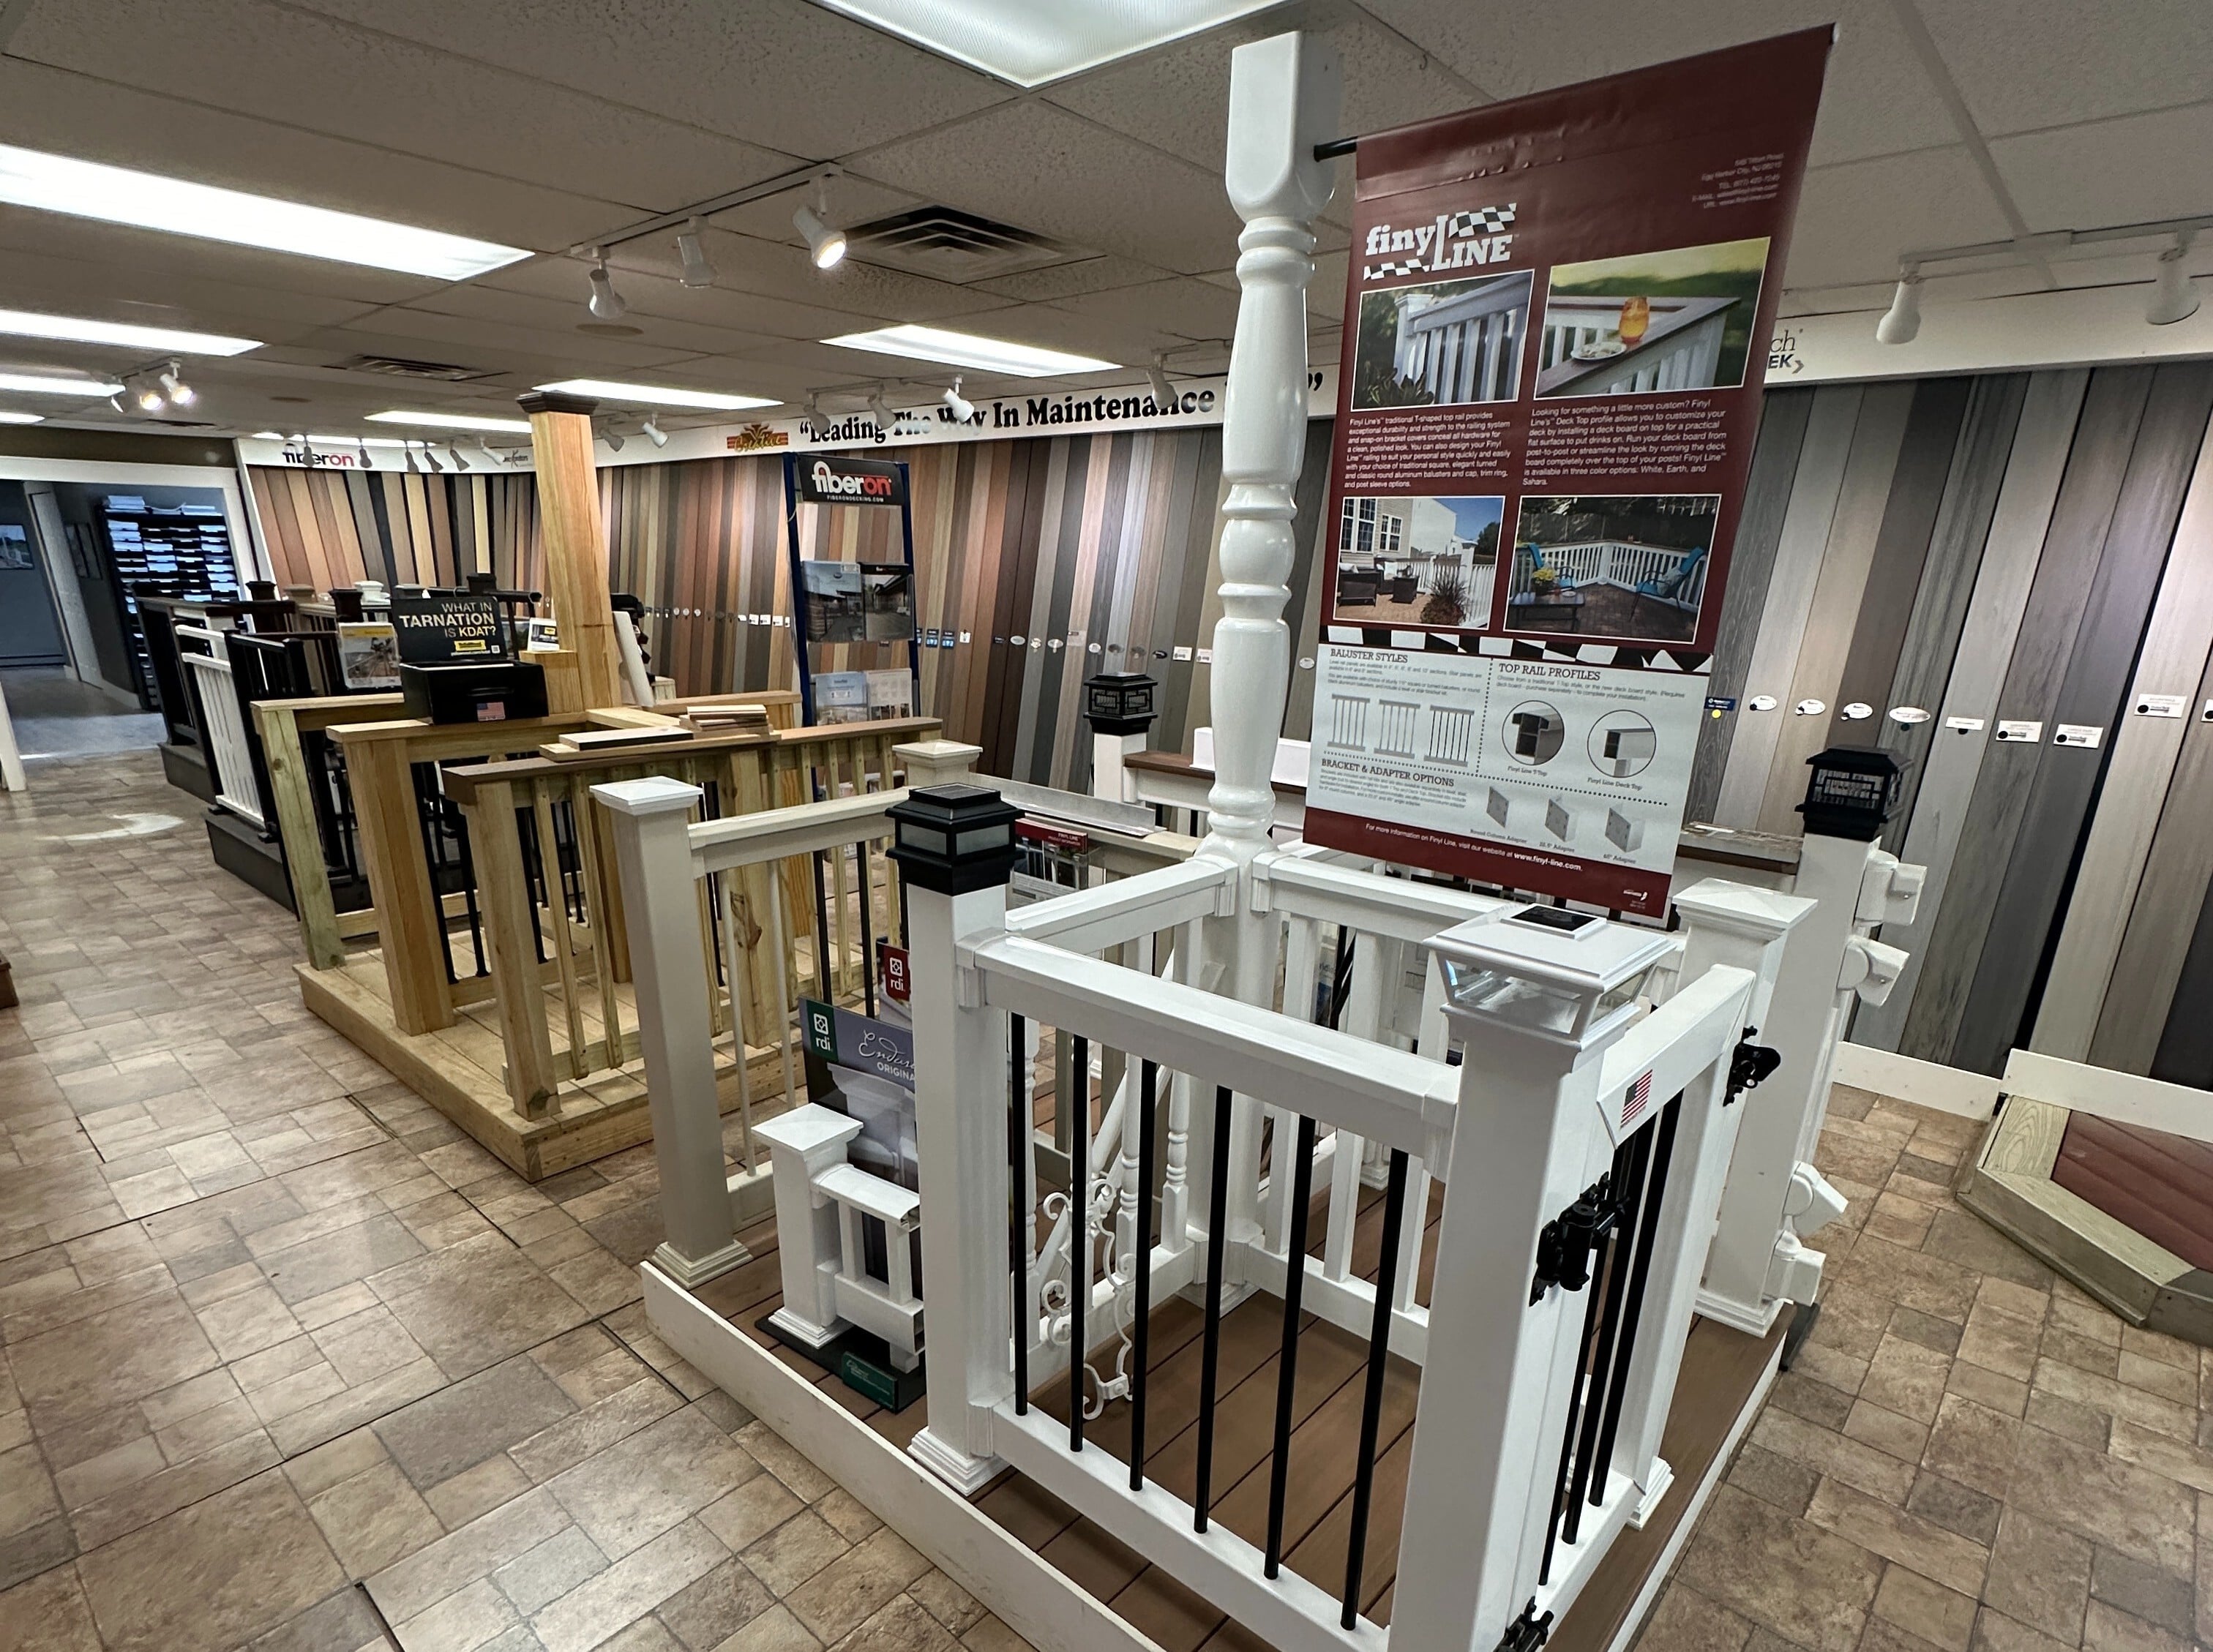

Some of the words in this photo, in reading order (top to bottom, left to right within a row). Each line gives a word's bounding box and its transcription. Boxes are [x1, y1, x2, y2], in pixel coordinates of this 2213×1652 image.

[937, 408, 987, 435] Wy
[992, 402, 1020, 429] In
[812, 461, 891, 496] fiberon
[441, 602, 476, 613] WHAT
[479, 602, 493, 612] IN
[399, 612, 495, 628] TARNATION
[444, 628, 457, 638] IS
[459, 626, 497, 637] KDAT?
[1330, 647, 1374, 661] BALUSTER
[1375, 652, 1409, 664] STYLES
[1498, 663, 1521, 674] TOP
[1521, 664, 1546, 676] RAIL
[1548, 667, 1601, 681] PROFILES
[1321, 758, 1360, 772] BRACKET
[1361, 765, 1368, 773] &
[1368, 765, 1412, 781] ADAPTER
[1412, 773, 1455, 787] OPTIONS
[891, 978, 905, 991] rdi
[815, 1037, 831, 1051] rdi
[877, 1062, 915, 1081] ORIGINA
